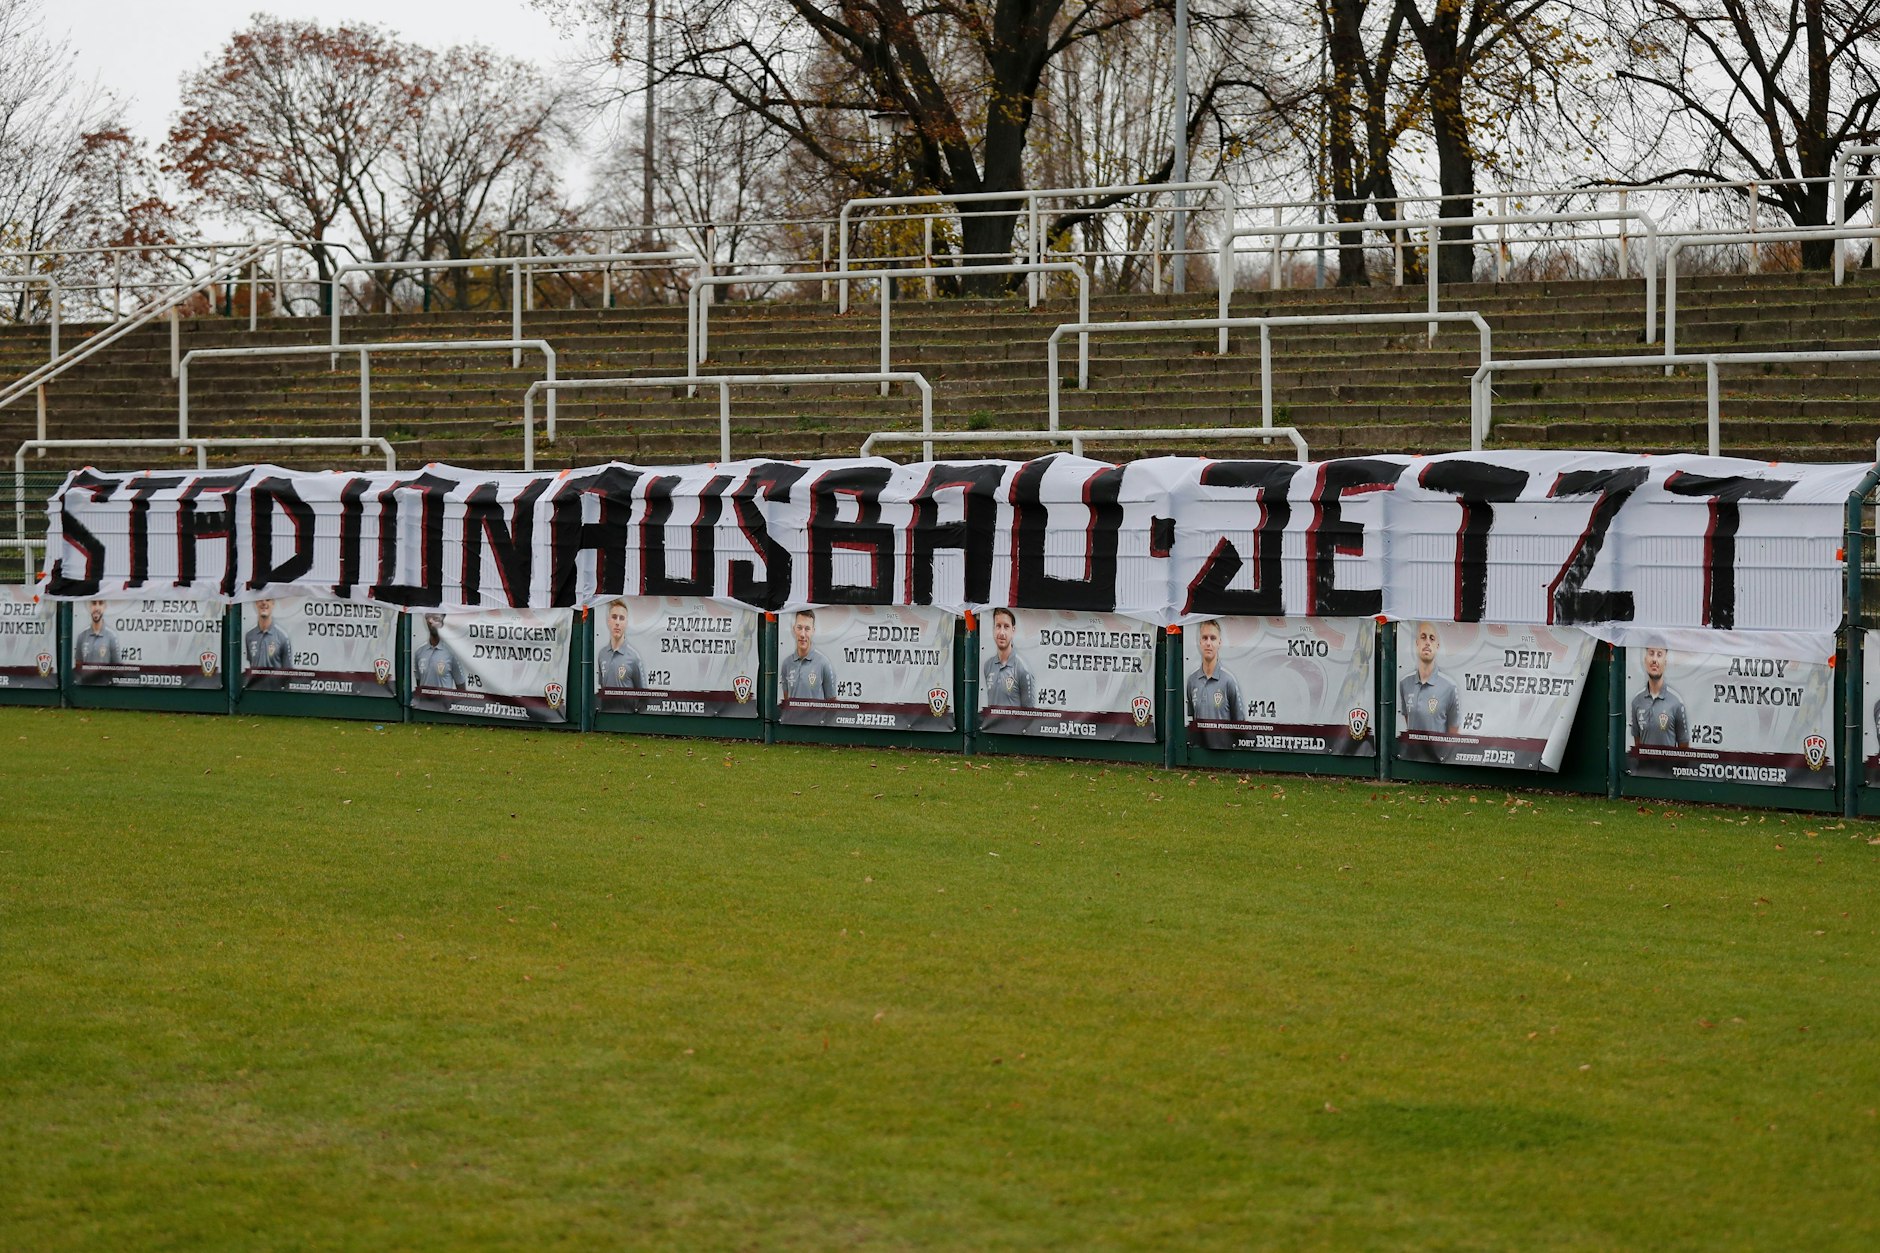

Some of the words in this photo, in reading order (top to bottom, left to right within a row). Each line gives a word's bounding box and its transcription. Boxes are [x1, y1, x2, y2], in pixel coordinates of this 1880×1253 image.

[3, 603, 37, 616] DREI
[160, 601, 199, 614] ESKA
[304, 602, 382, 618] GOLDENES
[308, 622, 378, 638] POTSDAM
[469, 624, 494, 639] DIE
[498, 626, 556, 642] DICKEN
[667, 617, 732, 633] FAMILIE
[867, 626, 920, 642] EDDIE
[1040, 630, 1152, 649] BODENLEGER
[661, 635, 737, 654] BÄRCHEN
[1287, 639, 1329, 657] KWO
[121, 648, 142, 661] #21
[293, 652, 319, 666] #20
[473, 645, 552, 662] DYNAMOS
[844, 647, 940, 666] WITTMANN
[1504, 650, 1552, 669] DEIN
[1048, 653, 1143, 673] SCHEFFLER
[1728, 657, 1789, 678] ANDY
[140, 674, 182, 686] DEDIDIS
[467, 674, 482, 687] #8
[648, 670, 671, 685] #12
[1465, 673, 1577, 697] WASSERBET
[837, 682, 862, 697] #13
[1038, 689, 1066, 705] #34
[1713, 684, 1804, 707] PANKOW
[485, 702, 529, 718] HÜTHER
[662, 701, 705, 713] HAINKE
[1248, 700, 1276, 717] #14
[836, 716, 855, 724] CHRIS
[856, 713, 896, 726] REHER
[1351, 711, 1366, 720] BFC
[1463, 713, 1483, 730] #5
[1059, 720, 1096, 736] BÄTGE
[1691, 725, 1723, 744] #25
[1255, 735, 1326, 751] BREITFELD
[1806, 738, 1824, 749] BFC
[1455, 753, 1482, 762] STEFFEN
[1483, 749, 1515, 764] EDER
[1672, 766, 1698, 777] TOBIAS
[1699, 763, 1787, 783] STOCKINGER
